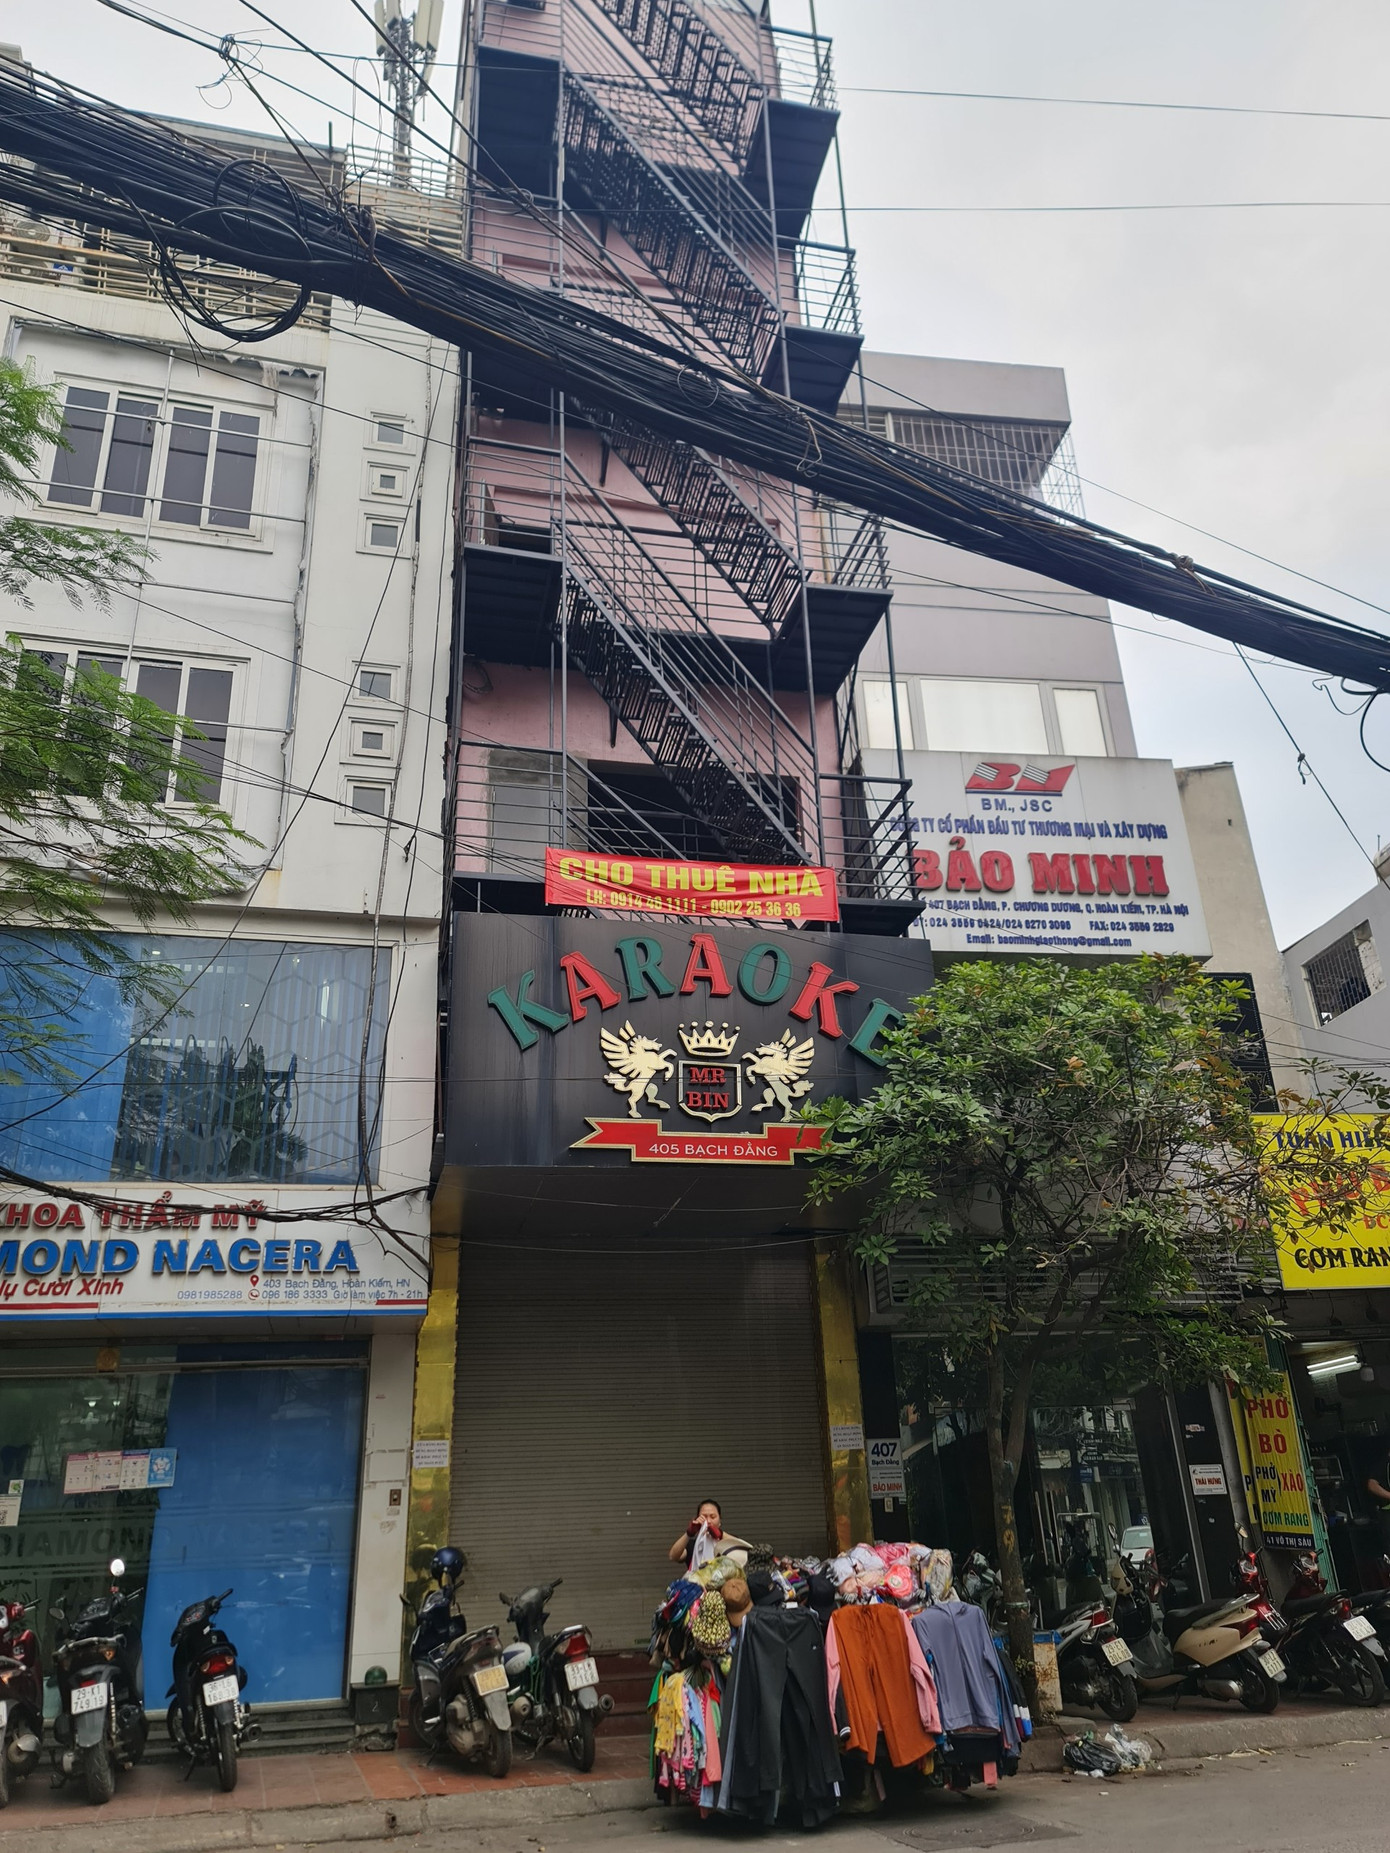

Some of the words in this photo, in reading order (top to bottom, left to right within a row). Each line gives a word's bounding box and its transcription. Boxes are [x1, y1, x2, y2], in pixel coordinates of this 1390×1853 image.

[1020, 799, 1053, 812] JSC
[921, 817, 935, 833] TY
[1028, 820, 1072, 837] THƯƠNG
[1074, 822, 1096, 840] MẠI
[1096, 820, 1112, 838] VÀ
[1113, 821, 1134, 839] XÂY
[1136, 823, 1168, 842] DỰNG
[906, 836, 1015, 893] BẢO
[1028, 853, 1169, 895] MINH
[560, 858, 634, 886] CHO
[645, 865, 736, 893] THUÊ
[748, 869, 823, 897] NHÀ
[586, 889, 606, 905] LH:
[610, 891, 642, 909] 0914
[666, 897, 696, 913] 1111
[711, 899, 743, 915] 0902
[746, 901, 762, 916] 25
[766, 902, 781, 917] 36
[785, 903, 801, 917] 36
[1145, 904, 1159, 914] TP.
[1160, 903, 1172, 915] HÀ
[930, 917, 948, 928] 024
[1089, 920, 1109, 931] FAX:
[1110, 921, 1127, 931] 024
[966, 933, 994, 945] Email:
[488, 932, 908, 1067] KARAOKE
[690, 1067, 726, 1084] MR
[686, 1091, 730, 1109] BIN
[649, 1143, 679, 1155] 405
[685, 1144, 728, 1157] BẠCH
[734, 1142, 778, 1157] ĐẰNG
[0, 1203, 85, 1228] HOA
[99, 1191, 201, 1229] THẨM
[211, 1199, 267, 1229] MỸ
[152, 1238, 360, 1275] NACERA
[23, 1278, 74, 1297] Cười
[76, 1278, 124, 1297] Xinh
[263, 1279, 281, 1289] 403
[285, 1279, 309, 1290] Bạch
[312, 1278, 338, 1291] Đằng,
[342, 1278, 367, 1289] Hoàn
[369, 1278, 393, 1290] Kiếm,
[396, 1279, 411, 1288] HN
[177, 1290, 243, 1300] 0981985288
[262, 1290, 280, 1299] 096
[284, 1290, 299, 1299] 186
[303, 1290, 328, 1299] 3333
[333, 1290, 348, 1299] Giờ
[351, 1290, 366, 1299] làm
[368, 1290, 385, 1300] việc
[388, 1290, 398, 1299] 7h
[406, 1290, 423, 1299] 21h
[1247, 1392, 1289, 1419] PHỞ
[871, 1442, 898, 1457] 407
[1258, 1428, 1288, 1454] BÒ
[1255, 1462, 1277, 1480] PHỞ
[1281, 1469, 1304, 1492] XÀO
[1261, 1487, 1277, 1504] MỲ
[1262, 1510, 1283, 1526] CƠM
[1284, 1512, 1310, 1527] RANG
